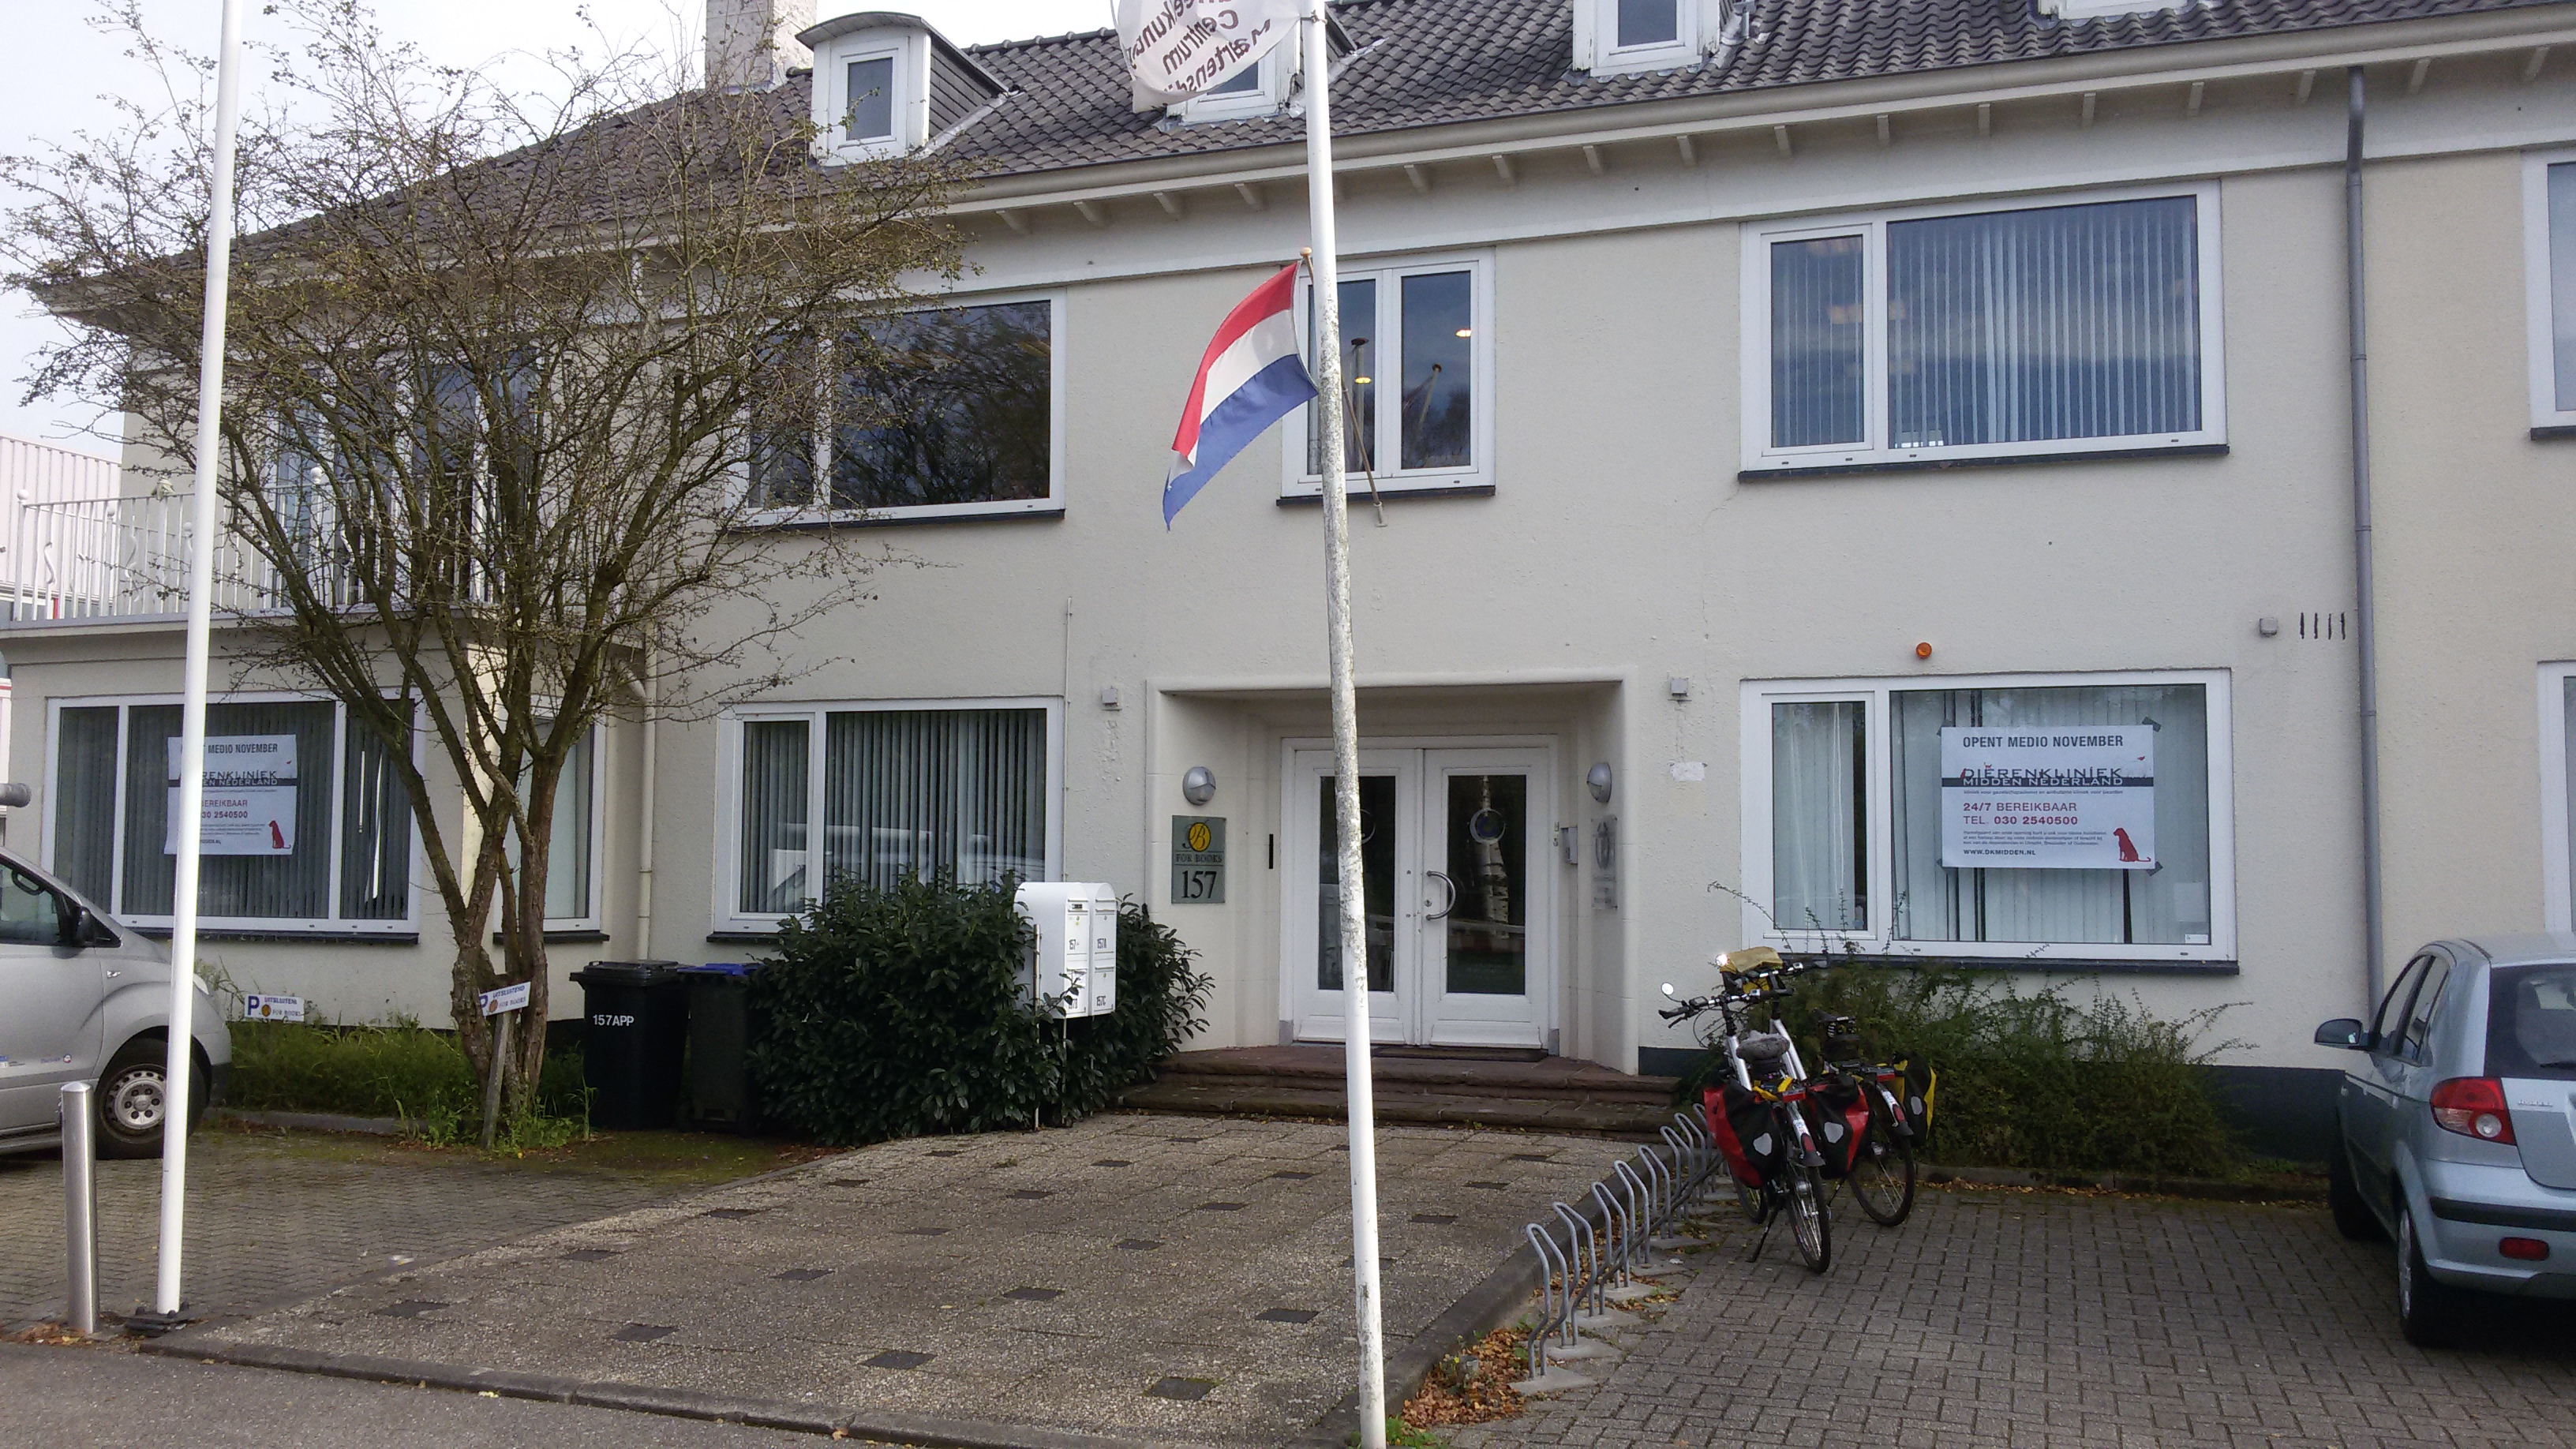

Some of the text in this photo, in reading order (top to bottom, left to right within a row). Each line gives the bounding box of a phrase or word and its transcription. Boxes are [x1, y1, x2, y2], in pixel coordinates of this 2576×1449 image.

[1963, 735, 2123, 747] OPENT MEDIO NOVEMBER
[208, 743, 278, 754] MEDIO NOVEMBER
[203, 769, 277, 780] RENKLINIEK
[2028, 777, 2123, 786] NEDERLAND
[1964, 803, 2077, 811] 24/7 BEREIKBAAR
[1964, 815, 2078, 825] TEL. 030 2540500
[1181, 871, 1217, 899] 157
[248, 996, 260, 1016] P
[593, 1014, 635, 1026] 157APP
